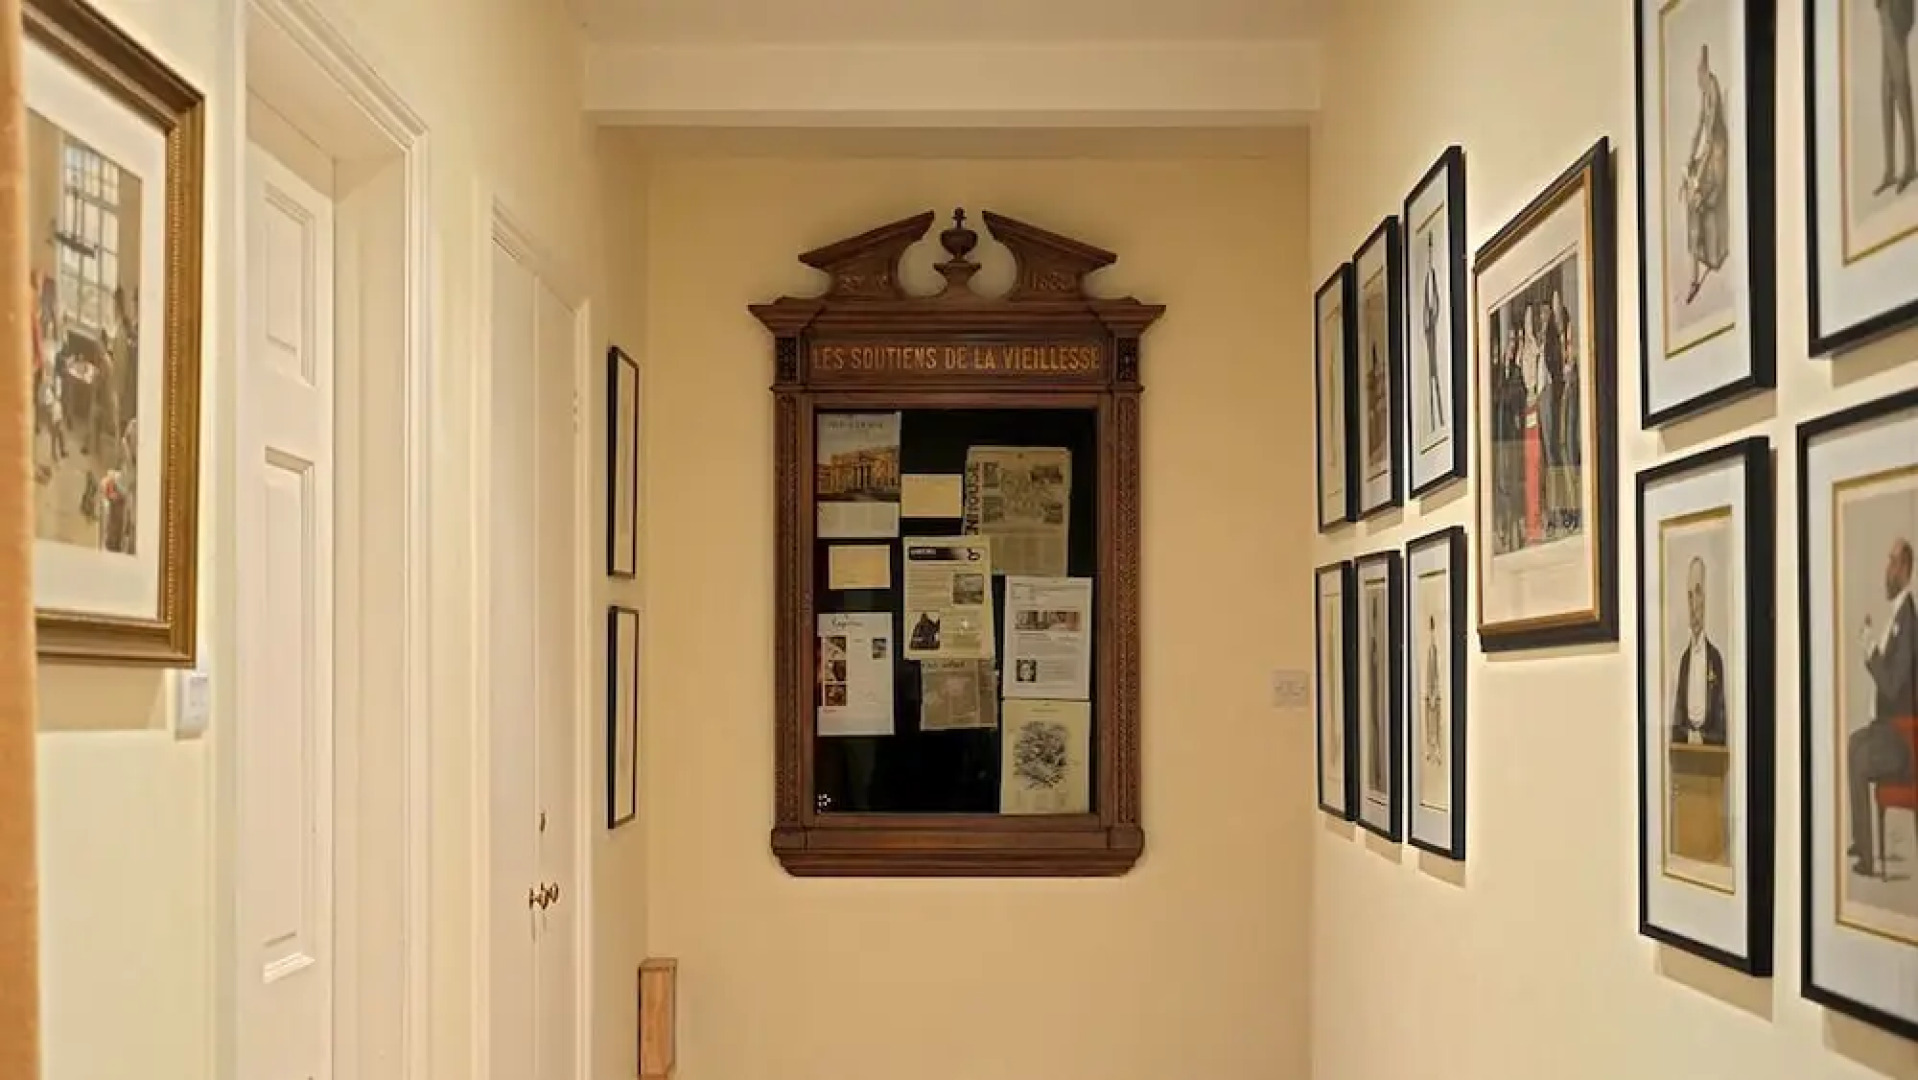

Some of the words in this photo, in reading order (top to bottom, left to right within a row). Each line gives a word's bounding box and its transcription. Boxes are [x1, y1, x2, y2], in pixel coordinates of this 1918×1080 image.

[814, 346, 844, 369] LES
[850, 346, 937, 369] SOUTIENS
[945, 346, 968, 369] DE
[974, 346, 996, 369] LA
[1002, 346, 1100, 369] VIEILLESSE
